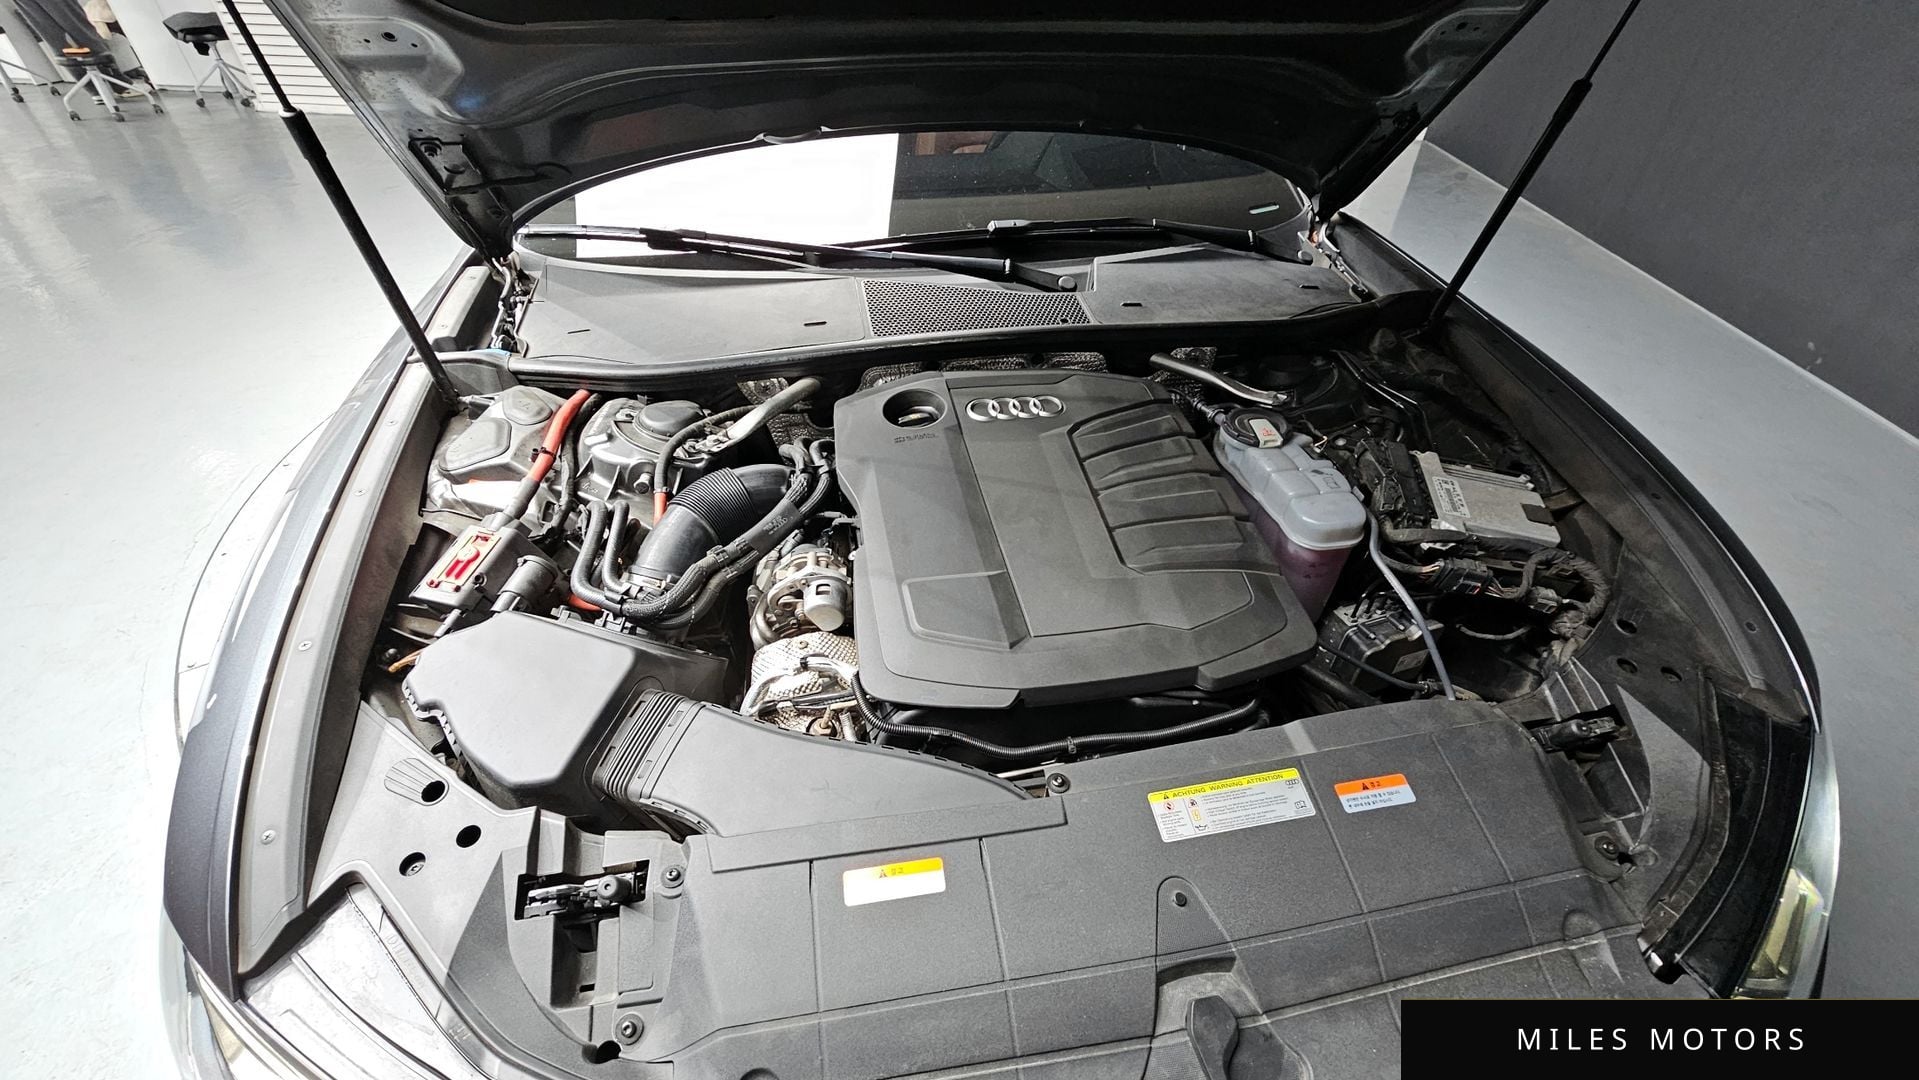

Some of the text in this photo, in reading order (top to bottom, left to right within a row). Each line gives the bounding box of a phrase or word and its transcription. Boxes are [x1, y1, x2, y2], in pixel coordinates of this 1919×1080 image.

[1172, 787, 1207, 798] ACHTUNG
[1210, 780, 1243, 791] WARNING
[1246, 774, 1285, 785] ATTENTION
